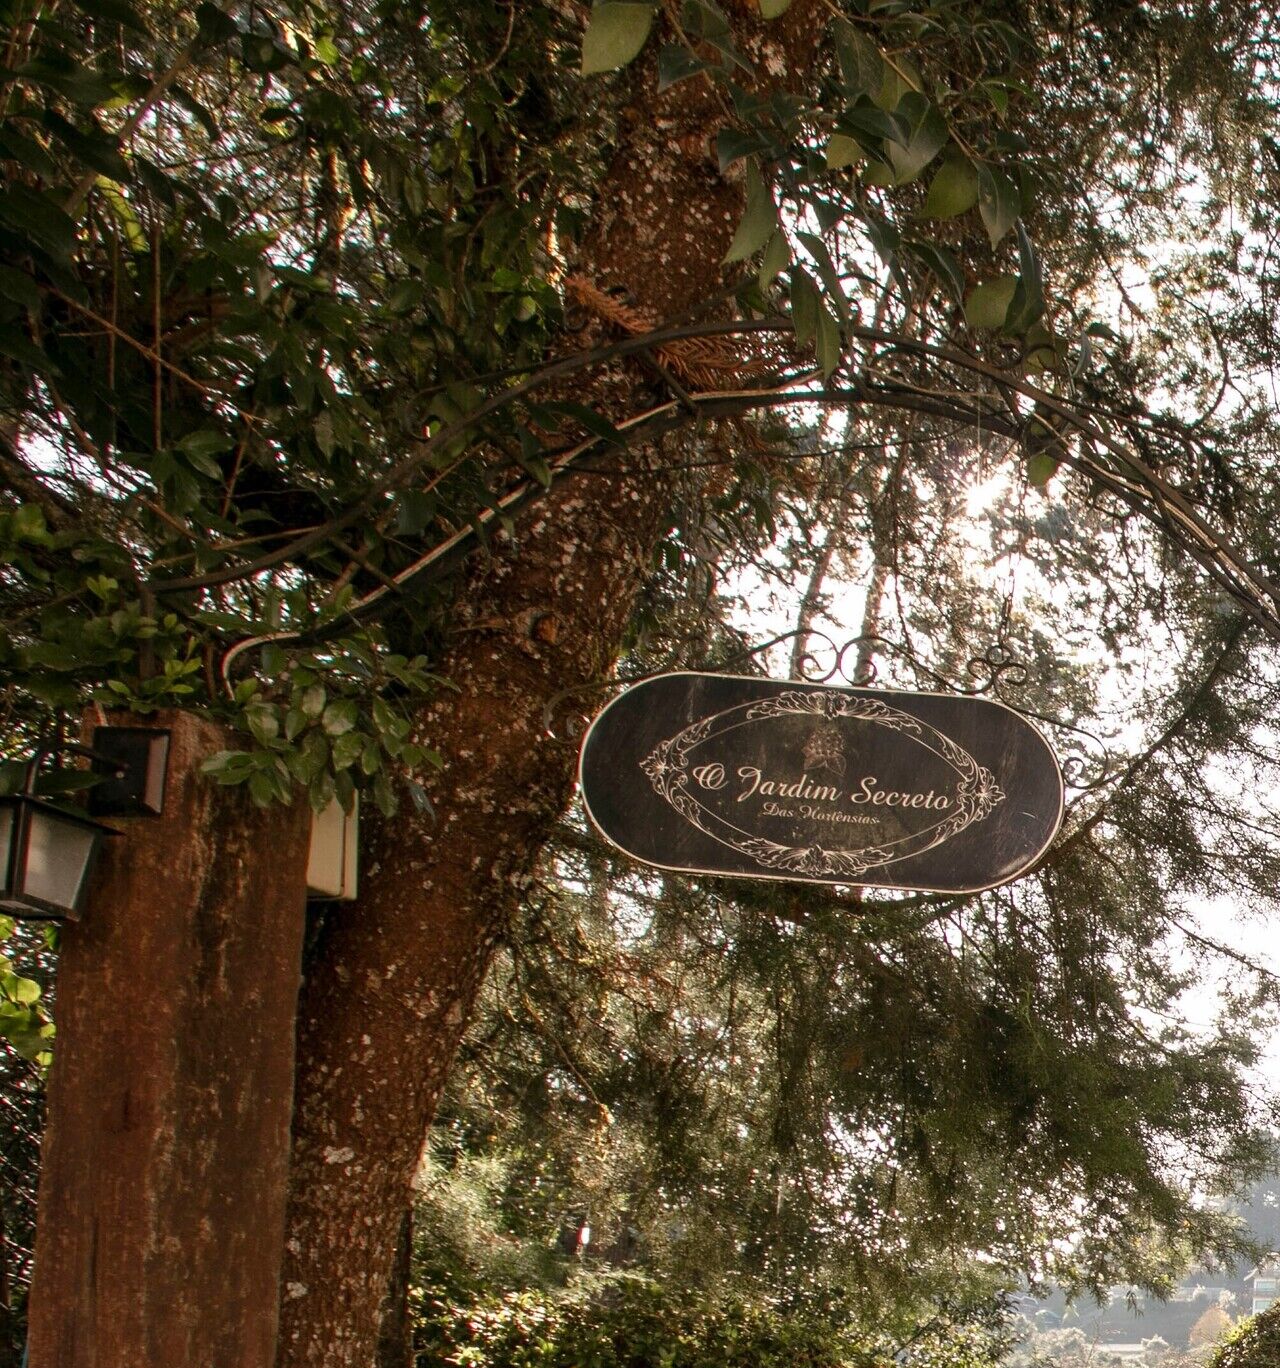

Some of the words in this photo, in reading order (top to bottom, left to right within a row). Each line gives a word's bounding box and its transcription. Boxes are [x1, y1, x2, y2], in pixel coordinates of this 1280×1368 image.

[692, 762, 729, 790] O
[736, 766, 843, 802] Jardim
[850, 776, 953, 811] Secreto
[761, 802, 795, 818] Das
